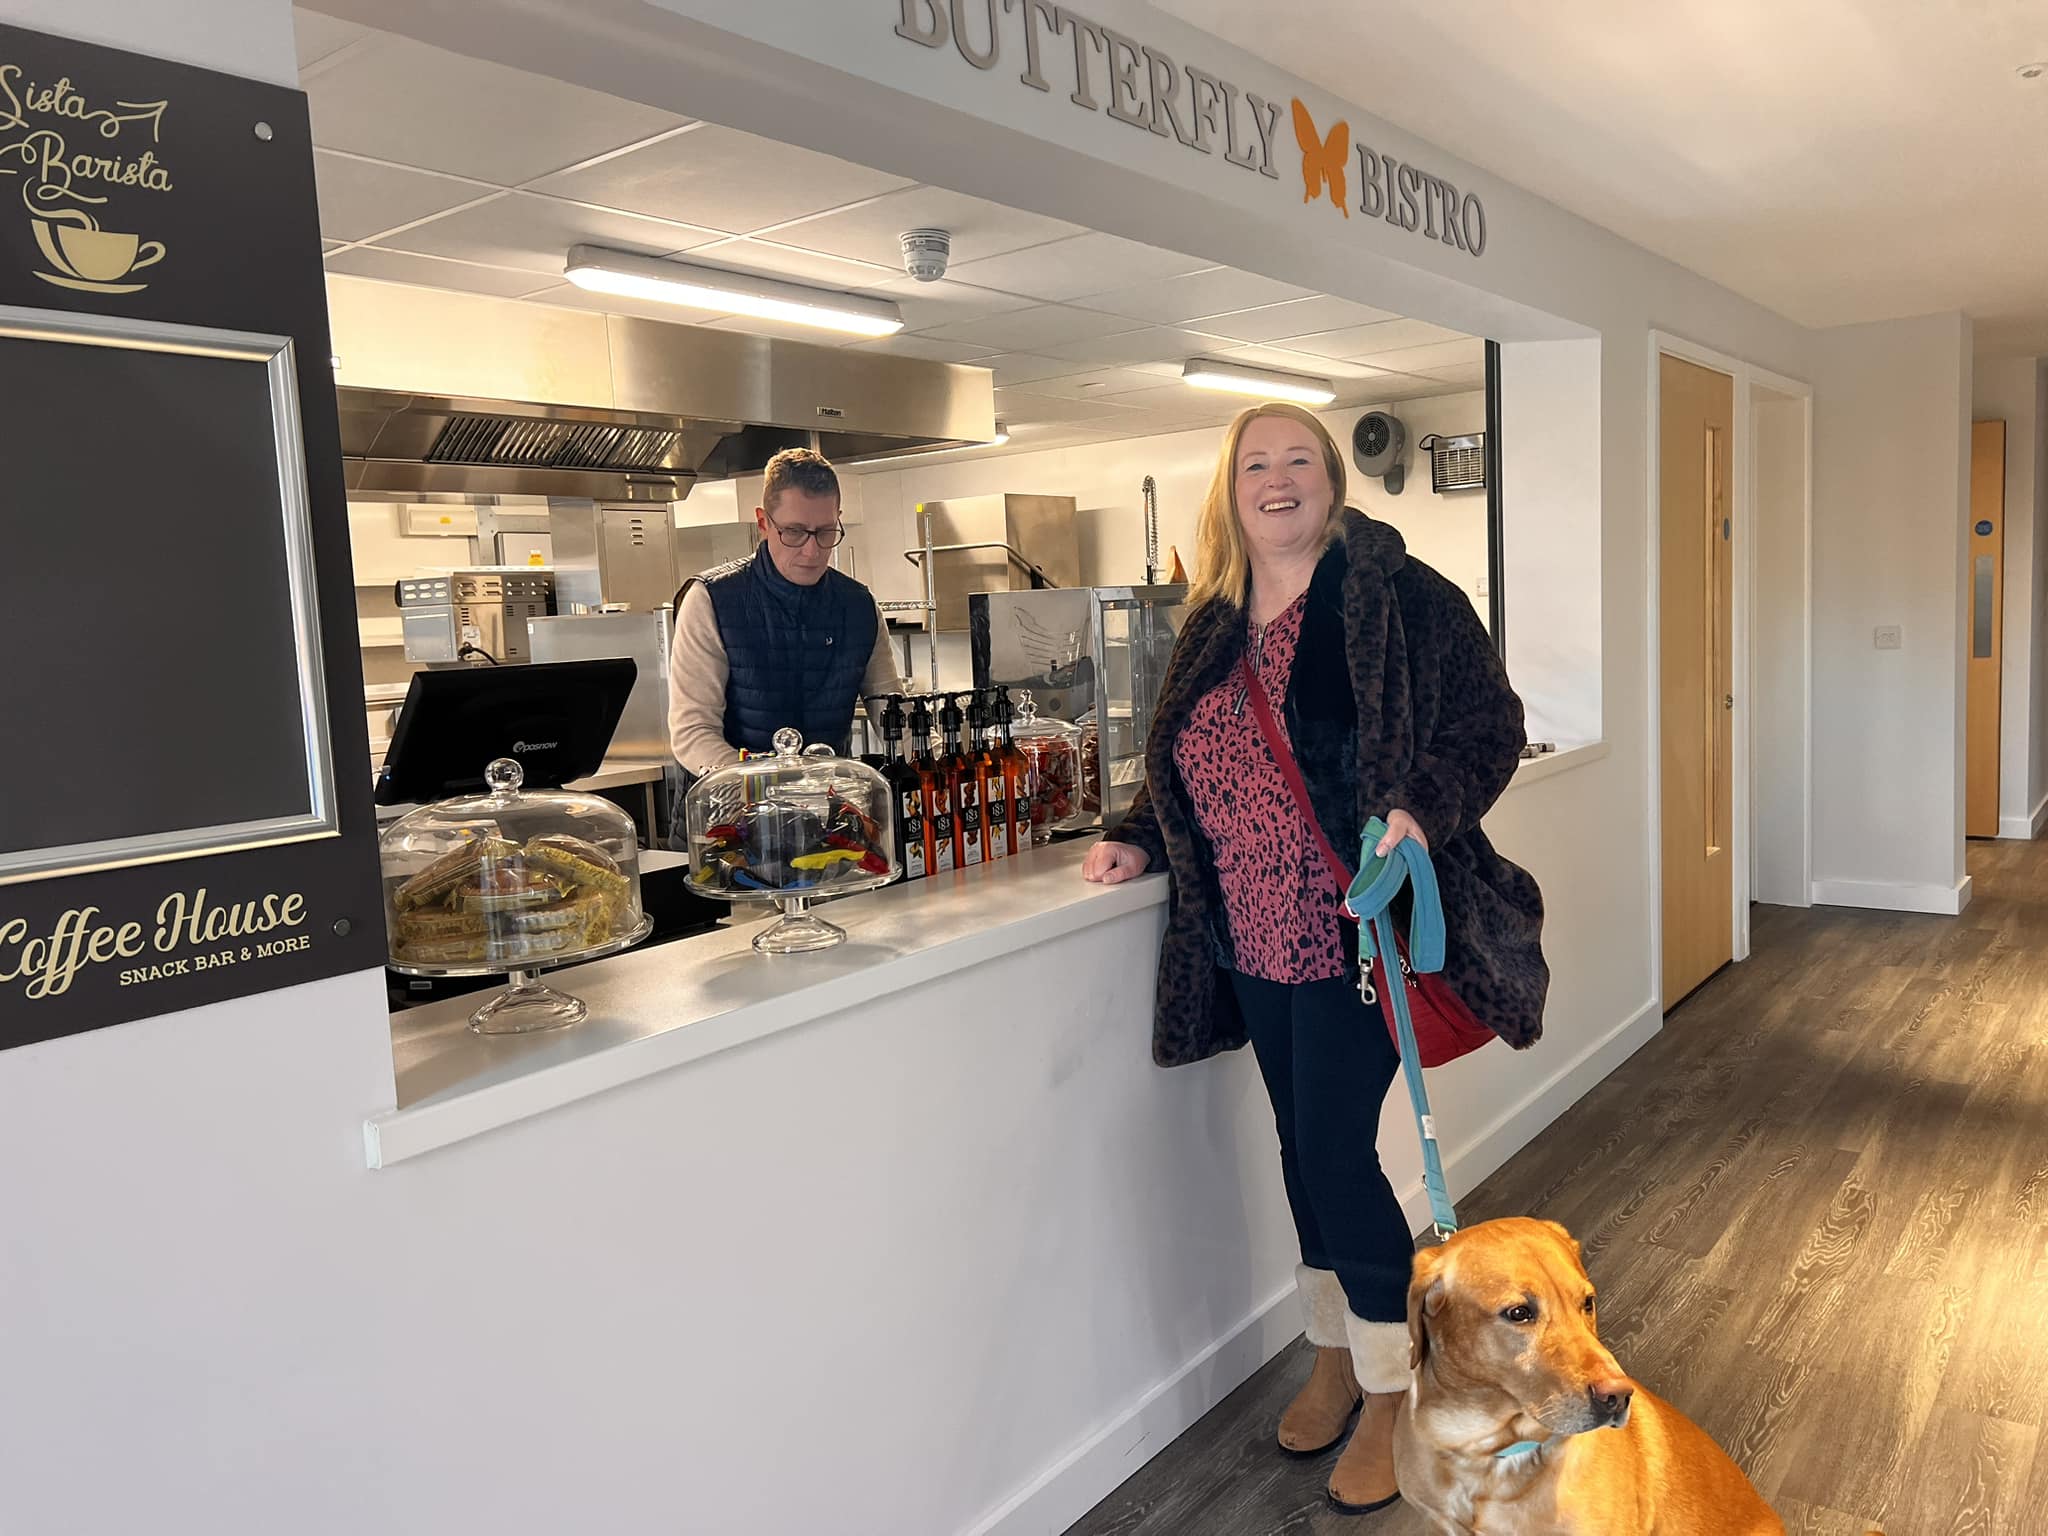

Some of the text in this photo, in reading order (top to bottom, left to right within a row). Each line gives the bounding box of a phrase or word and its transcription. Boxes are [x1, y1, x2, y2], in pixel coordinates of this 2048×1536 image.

[0, 64, 118, 137] Sista
[22, 130, 173, 203] Barista
[1356, 142, 1488, 257] BISTRO
[0, 888, 307, 1000] Coffee House
[119, 935, 311, 986] SNACK BAR & MORE
